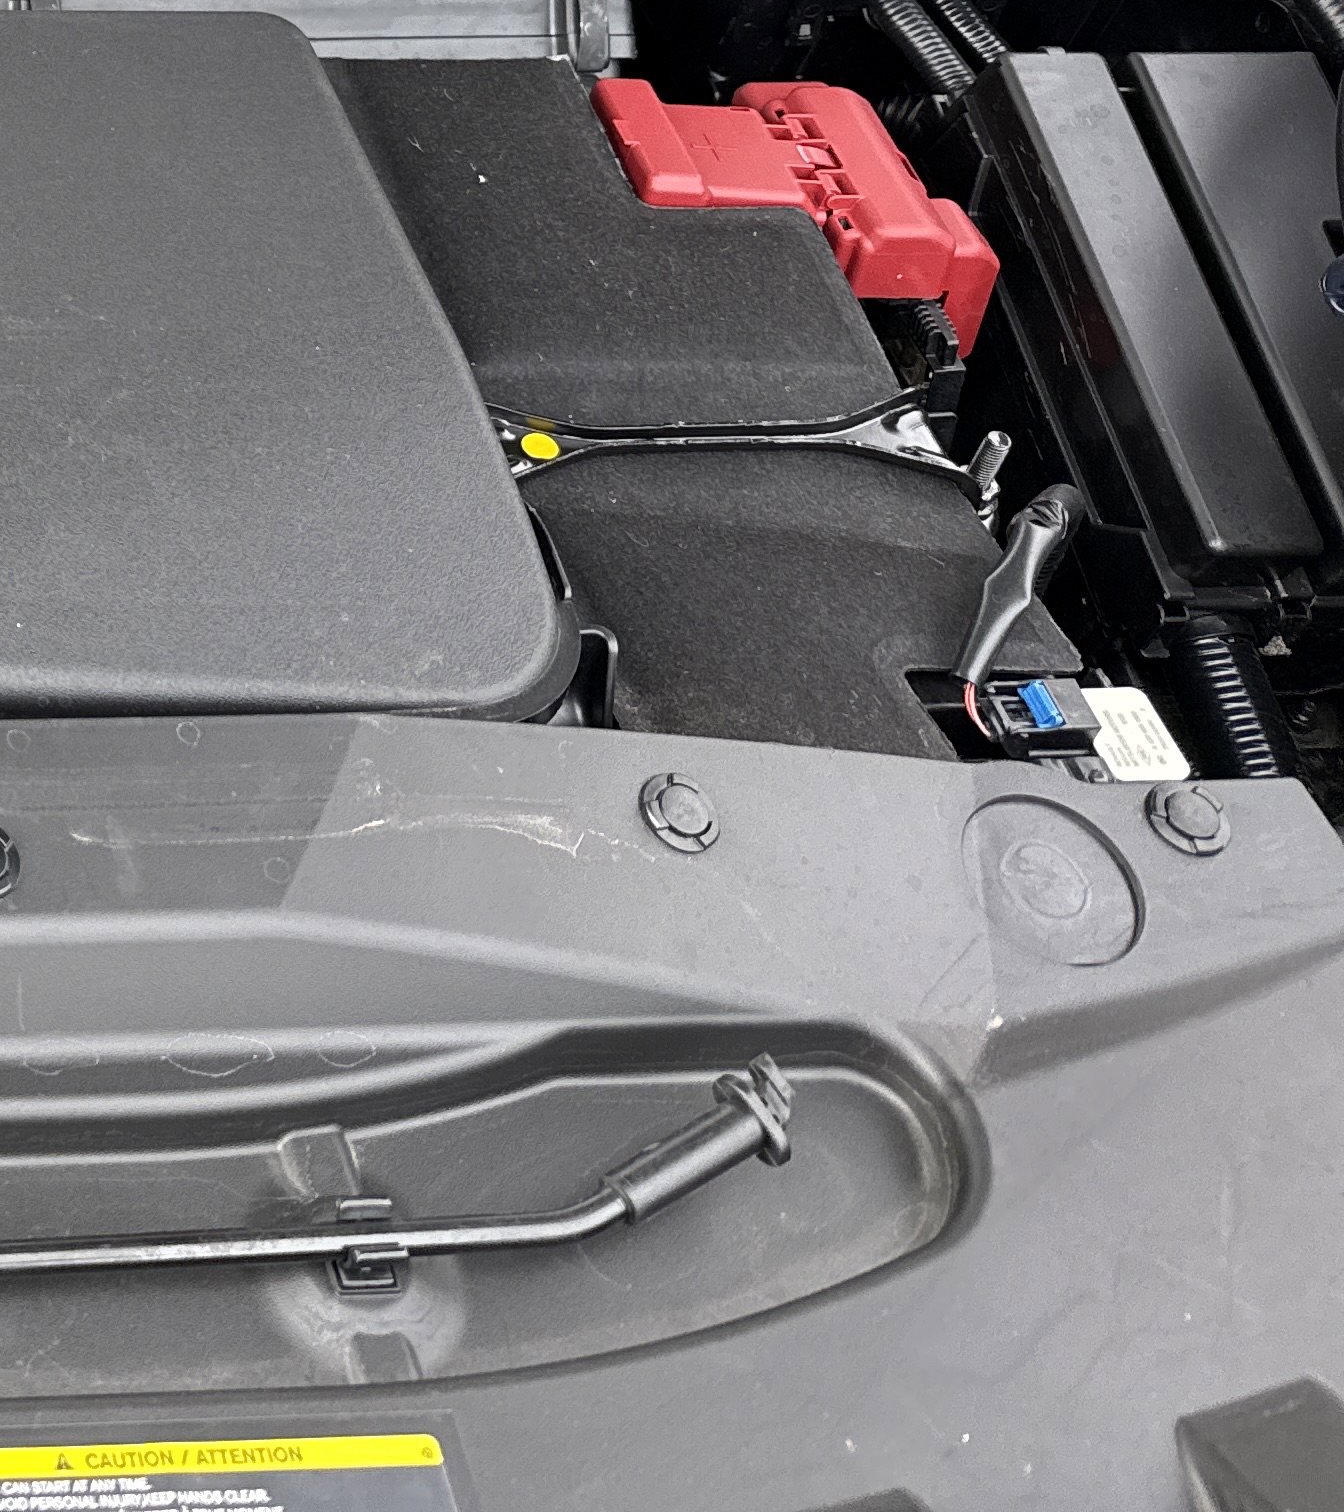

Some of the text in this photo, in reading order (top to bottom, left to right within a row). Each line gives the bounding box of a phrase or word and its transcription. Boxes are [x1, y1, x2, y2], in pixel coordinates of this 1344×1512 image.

[85, 1449, 174, 1469] CAUTION
[196, 1445, 303, 1466] ATTENTION
[2, 1481, 30, 1496] CAN
[31, 1480, 71, 1494] START
[29, 1495, 98, 1511] PERSONAL
